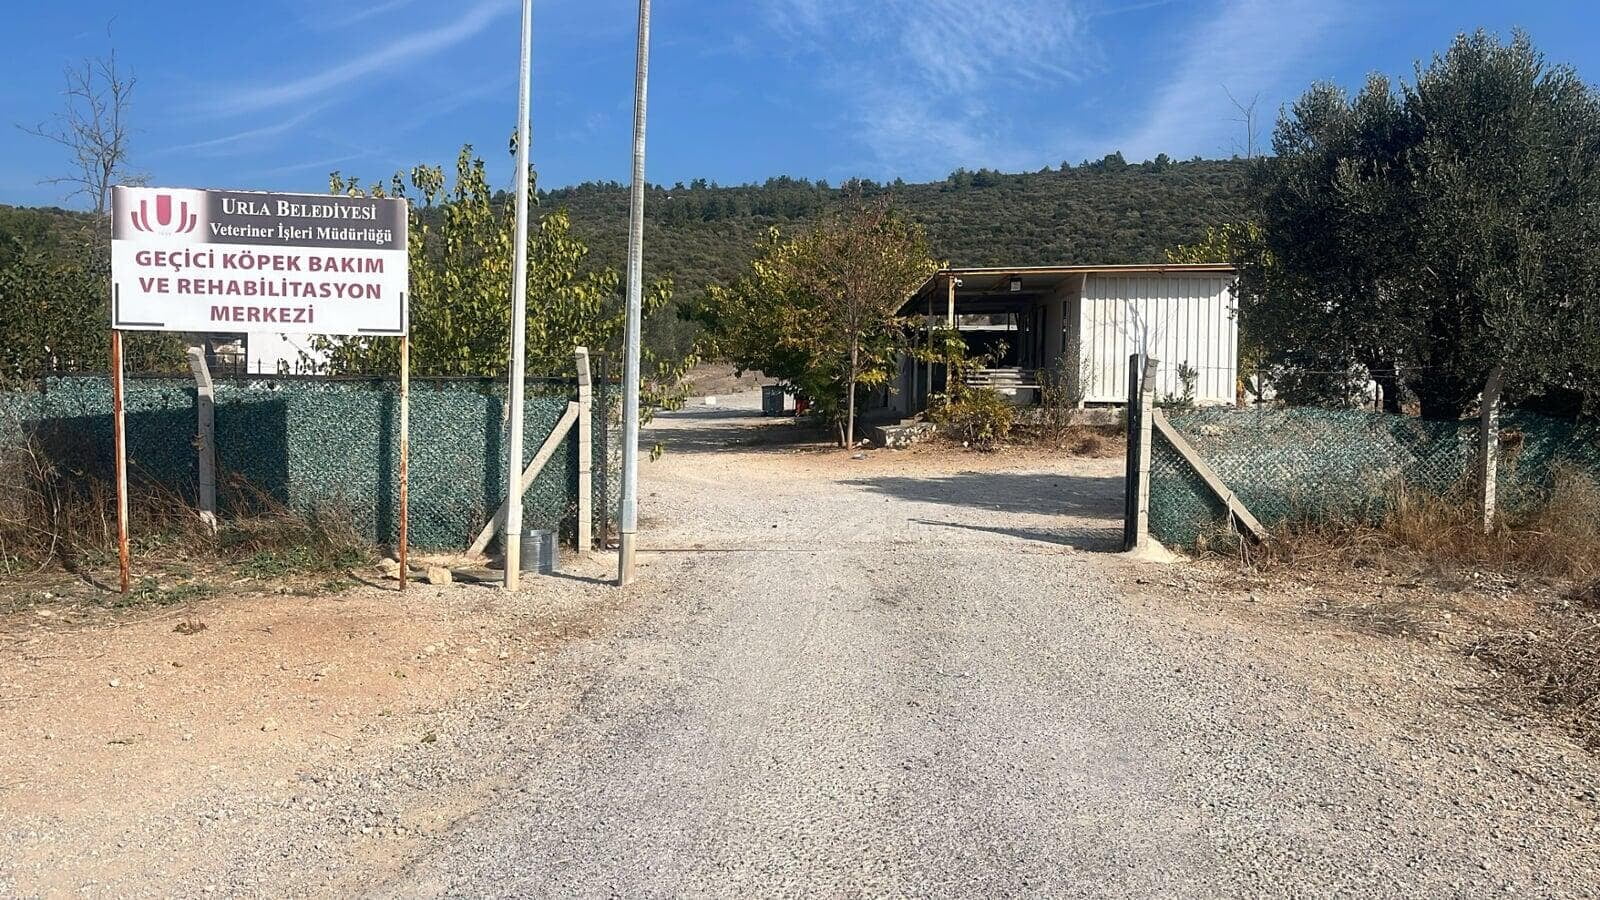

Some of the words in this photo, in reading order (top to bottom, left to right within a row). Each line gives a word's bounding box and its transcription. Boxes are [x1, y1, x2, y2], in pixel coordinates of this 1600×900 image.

[222, 198, 271, 216] URLA
[277, 200, 377, 220] BELEDİYESİ
[210, 222, 275, 239] Veteriner
[277, 223, 313, 241] İşleri
[316, 229, 393, 245] Müdürlüğü
[135, 249, 215, 272] GEÇİCİ
[222, 251, 302, 272] KÖPEK
[308, 256, 385, 274] BAKIM
[139, 277, 170, 294] VE
[177, 277, 382, 300] REHABİLİTASYON
[210, 304, 315, 324] MERKEZİ
